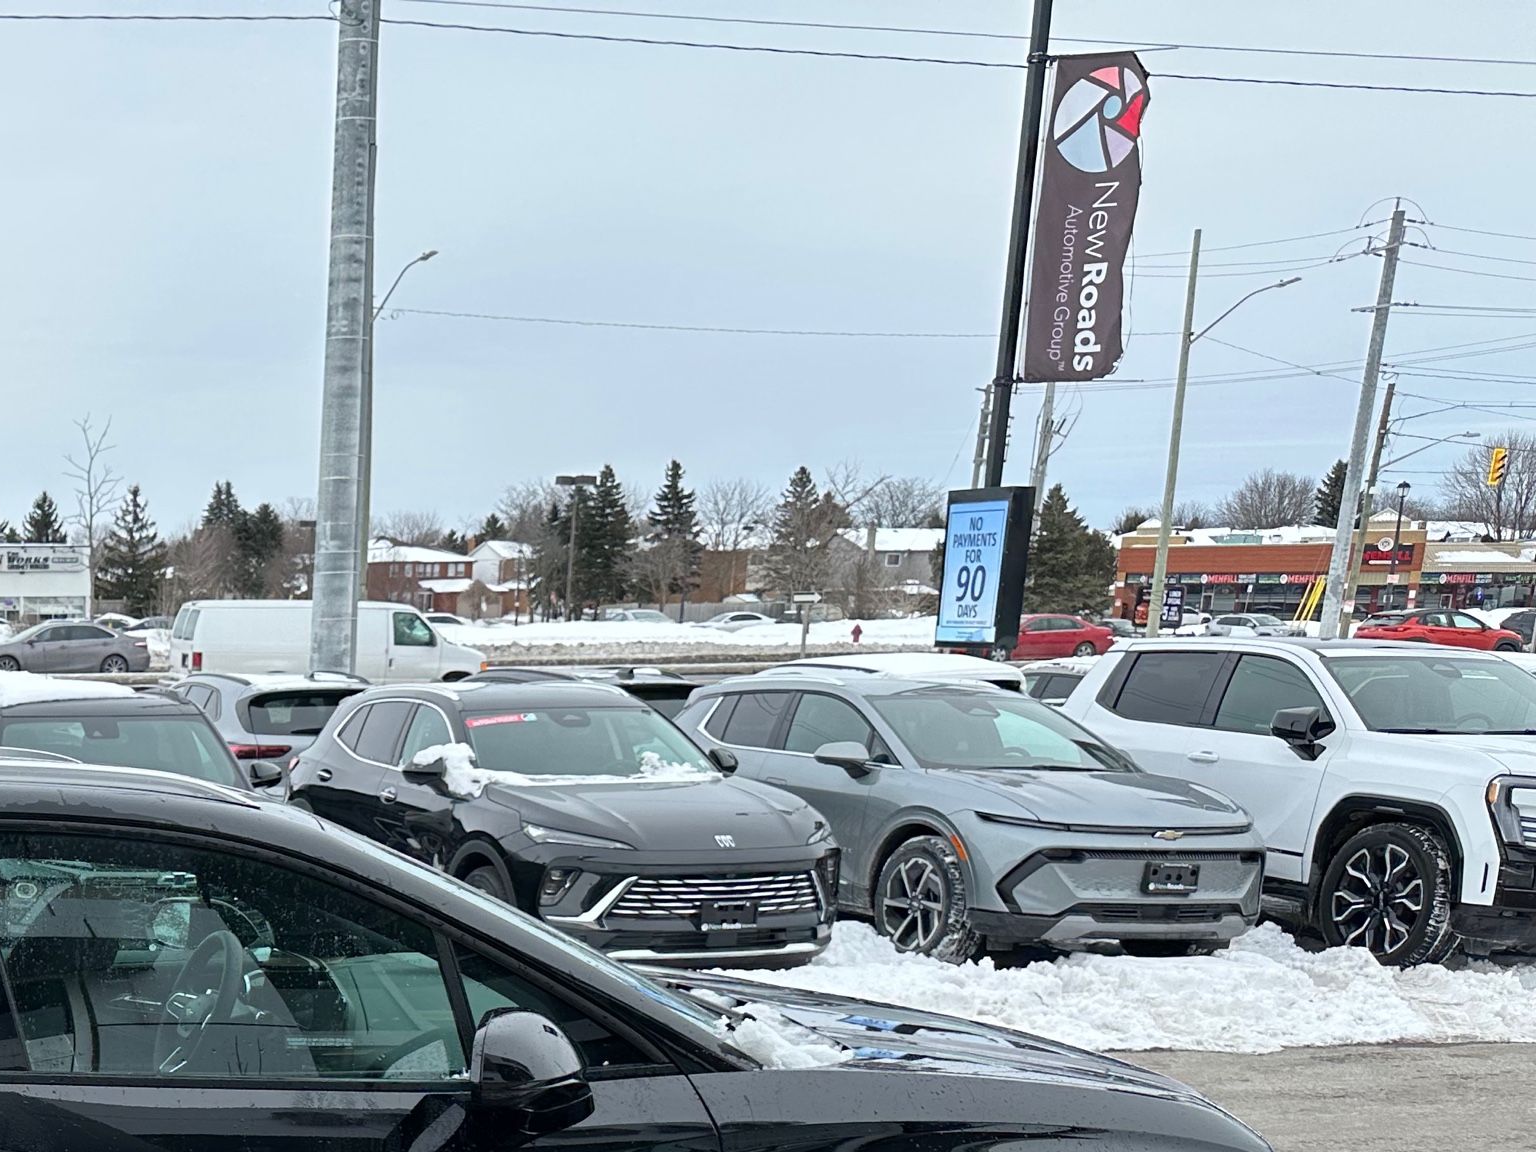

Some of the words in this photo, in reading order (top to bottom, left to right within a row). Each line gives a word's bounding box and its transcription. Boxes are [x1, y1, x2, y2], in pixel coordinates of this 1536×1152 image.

[1055, 204, 1084, 303] Automotive
[969, 516, 984, 532] NO
[952, 532, 998, 549] PAYMENTS
[965, 549, 982, 563] FOR
[955, 565, 986, 602] 90
[957, 604, 979, 618] DAYS
